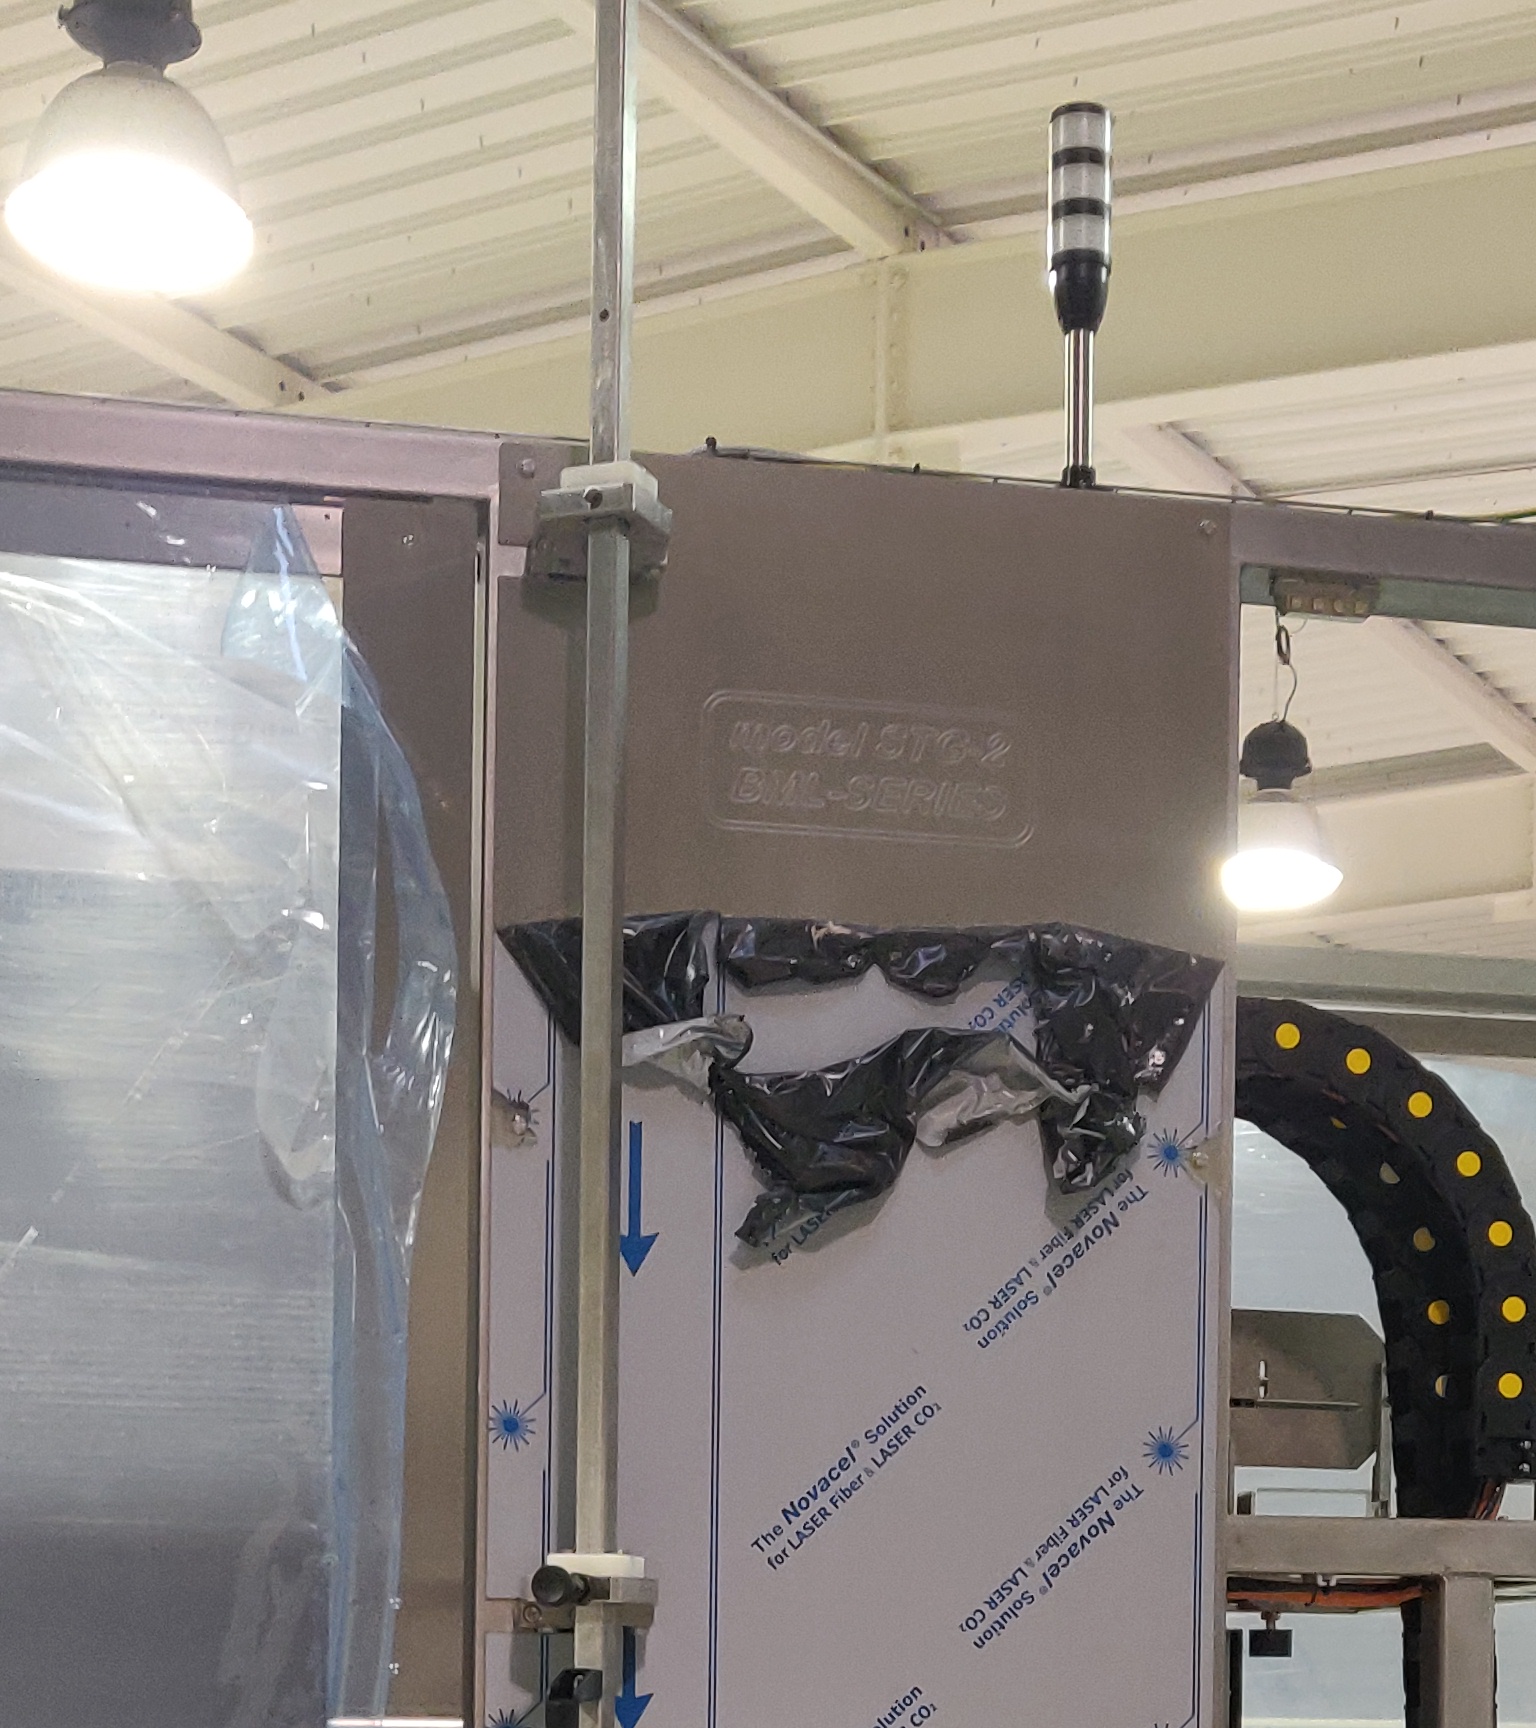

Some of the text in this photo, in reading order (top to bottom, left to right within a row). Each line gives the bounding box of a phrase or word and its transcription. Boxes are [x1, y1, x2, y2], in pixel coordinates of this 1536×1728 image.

[728, 718, 870, 759] model
[1114, 1169, 1133, 1189] for
[1118, 1185, 1149, 1211] The
[1070, 1187, 1114, 1229] LASER
[1040, 1226, 1074, 1260] Fiber
[988, 1266, 1032, 1310] LASER
[977, 1290, 1039, 1348] Solution
[751, 1525, 783, 1552] The
[864, 1386, 926, 1444] Solution
[1108, 1466, 1129, 1488] for
[767, 1547, 789, 1570] for
[787, 1507, 832, 1550] LASER
[829, 1474, 864, 1509] Fiber
[871, 1425, 916, 1469] LASER
[1066, 1485, 1110, 1528] LASER
[1113, 1483, 1144, 1510] The
[1035, 1526, 1069, 1562] Fiber
[983, 1567, 1028, 1610] LASER
[973, 1590, 1035, 1649] Solution
